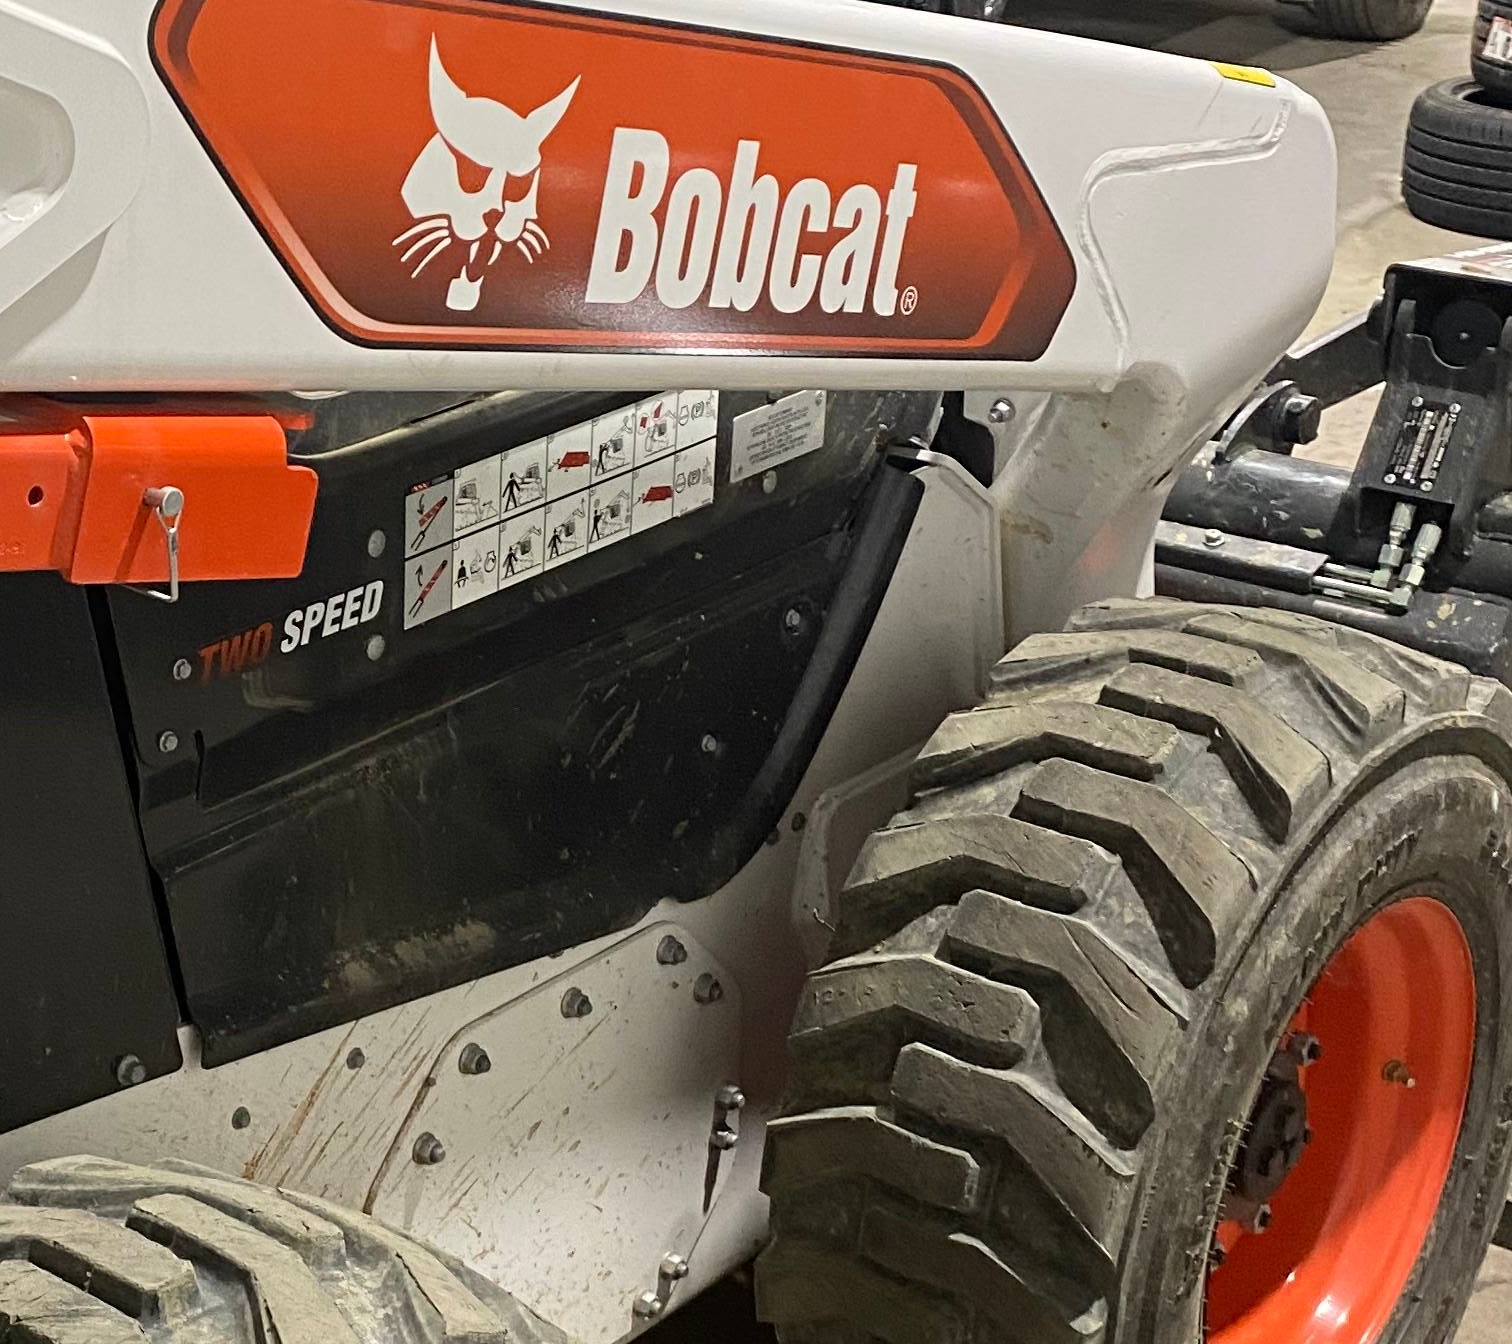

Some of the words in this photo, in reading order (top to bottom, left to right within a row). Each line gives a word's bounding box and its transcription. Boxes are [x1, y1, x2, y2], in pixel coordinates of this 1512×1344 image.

[585, 126, 918, 317] Bobcat
[198, 621, 274, 683] TWO
[280, 579, 385, 655] SPEED
